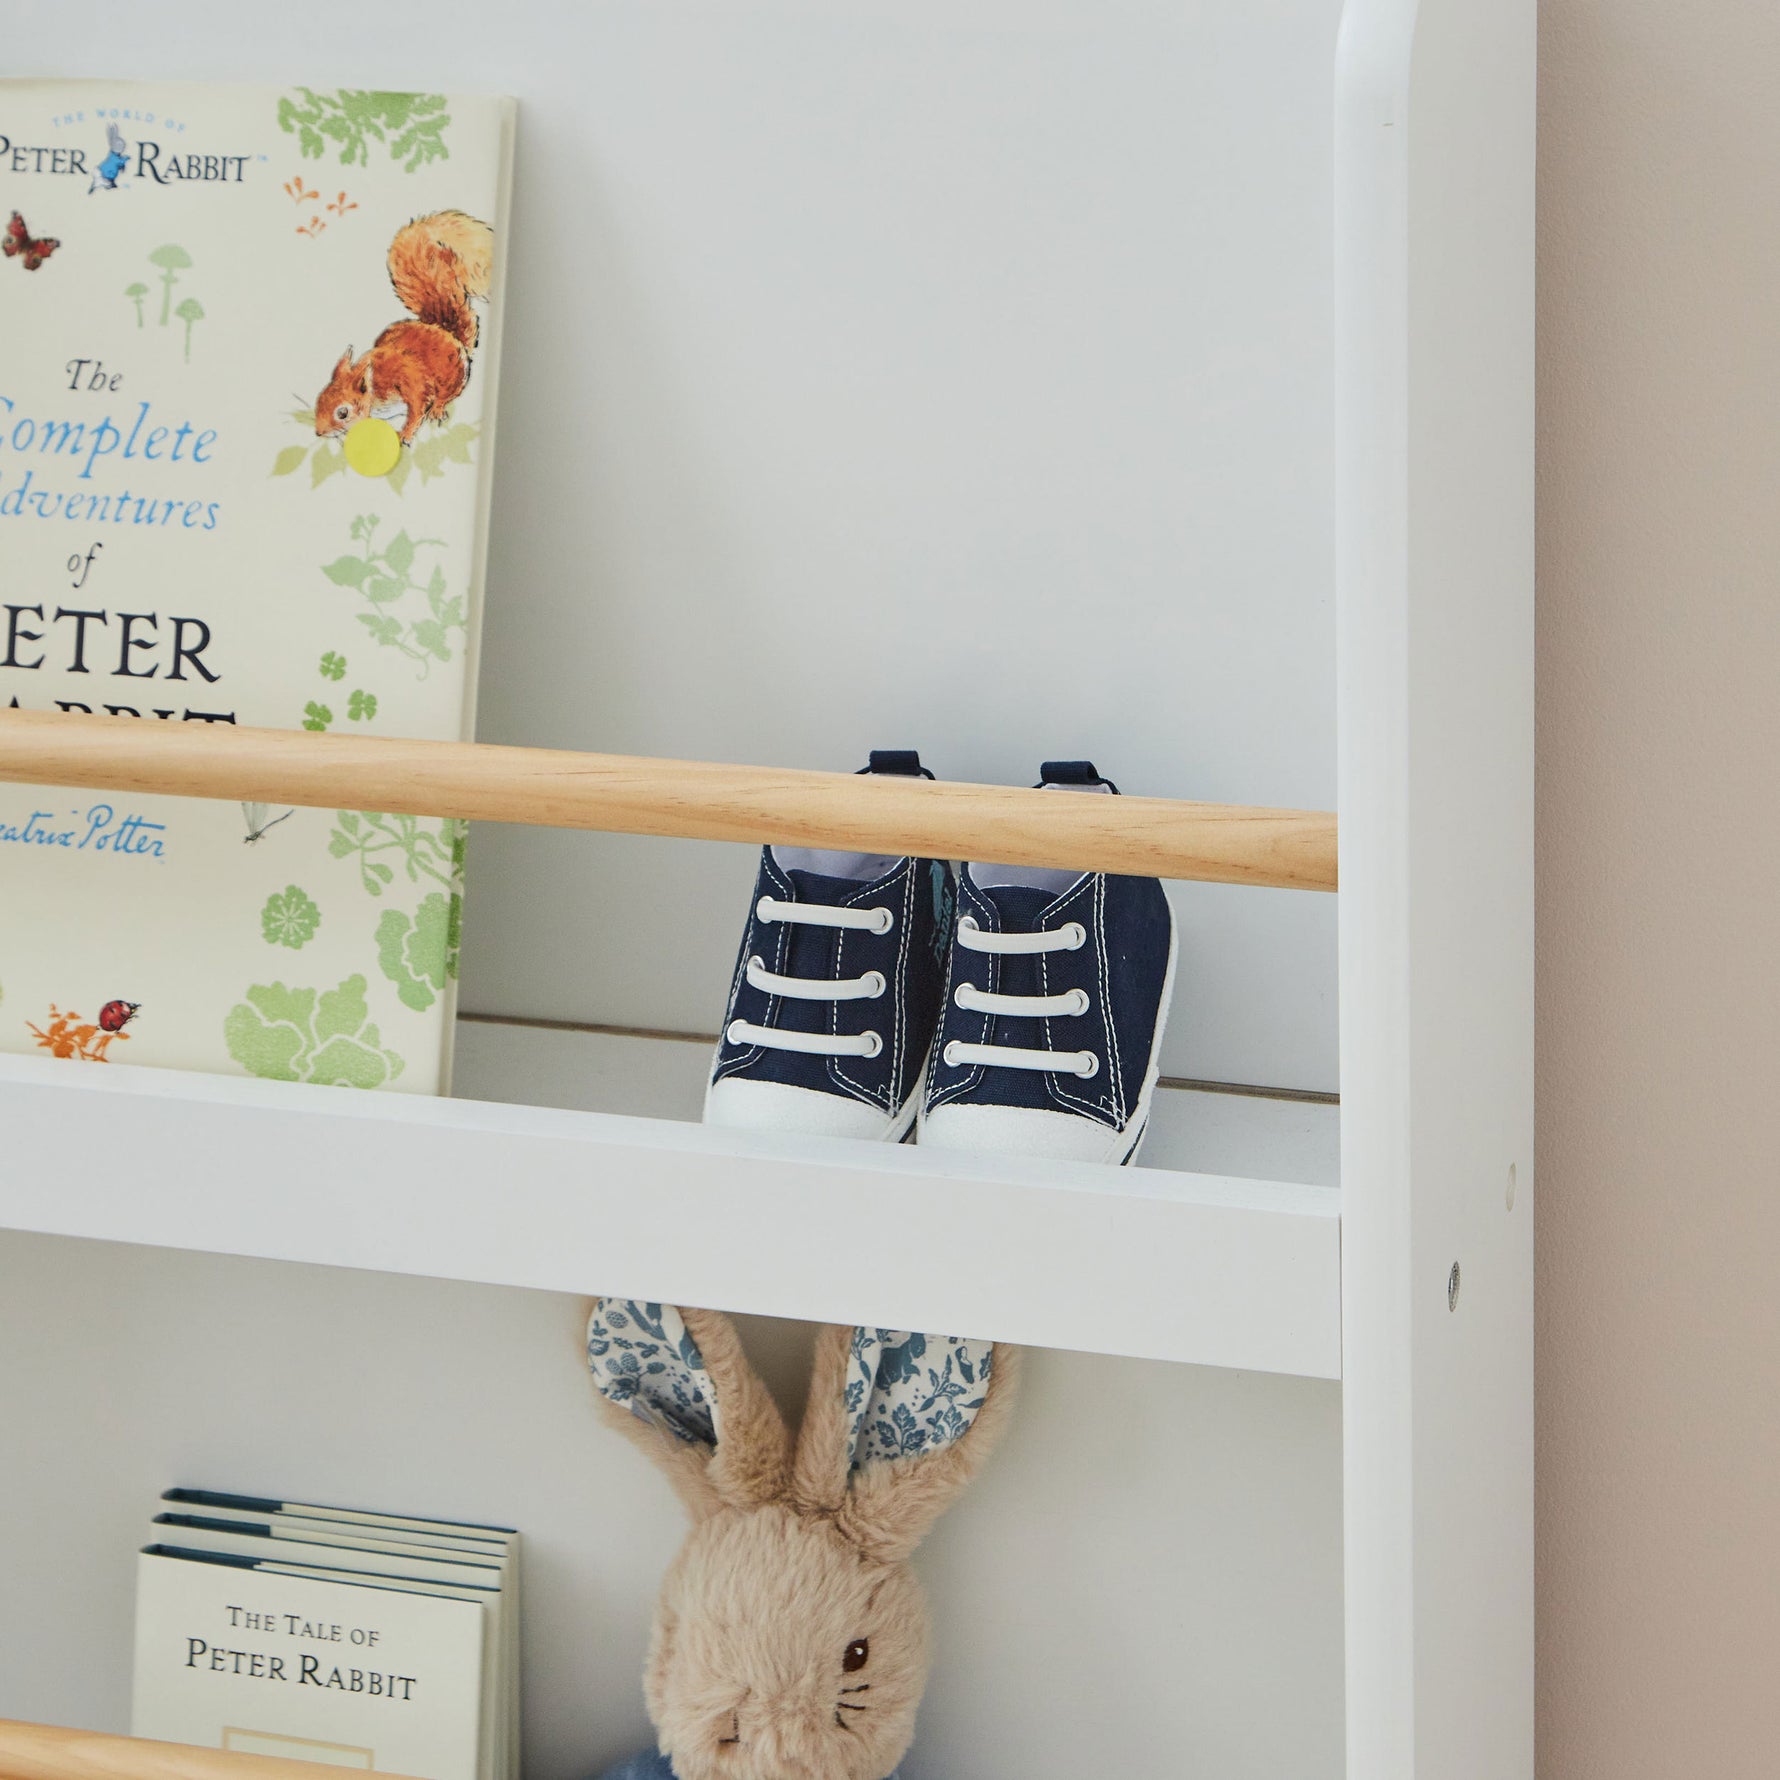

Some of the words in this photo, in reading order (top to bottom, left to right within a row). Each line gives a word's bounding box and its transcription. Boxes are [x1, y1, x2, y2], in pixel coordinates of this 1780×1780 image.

[53, 111, 85, 128] THE
[96, 108, 155, 123] WORLD
[164, 118, 186, 133] OF
[134, 141, 250, 185] RABBIT
[66, 359, 123, 391] The
[0, 396, 217, 479] omplete
[0, 470, 220, 530] dventures
[67, 542, 103, 588] of
[0, 603, 221, 683] ETER
[0, 811, 78, 847] atrix
[78, 804, 166, 857] Potter
[226, 1605, 275, 1632] THE
[284, 1614, 342, 1642] TALE
[350, 1628, 380, 1647] OF
[185, 1637, 287, 1681] PETER
[298, 1654, 416, 1700] RABBIT
